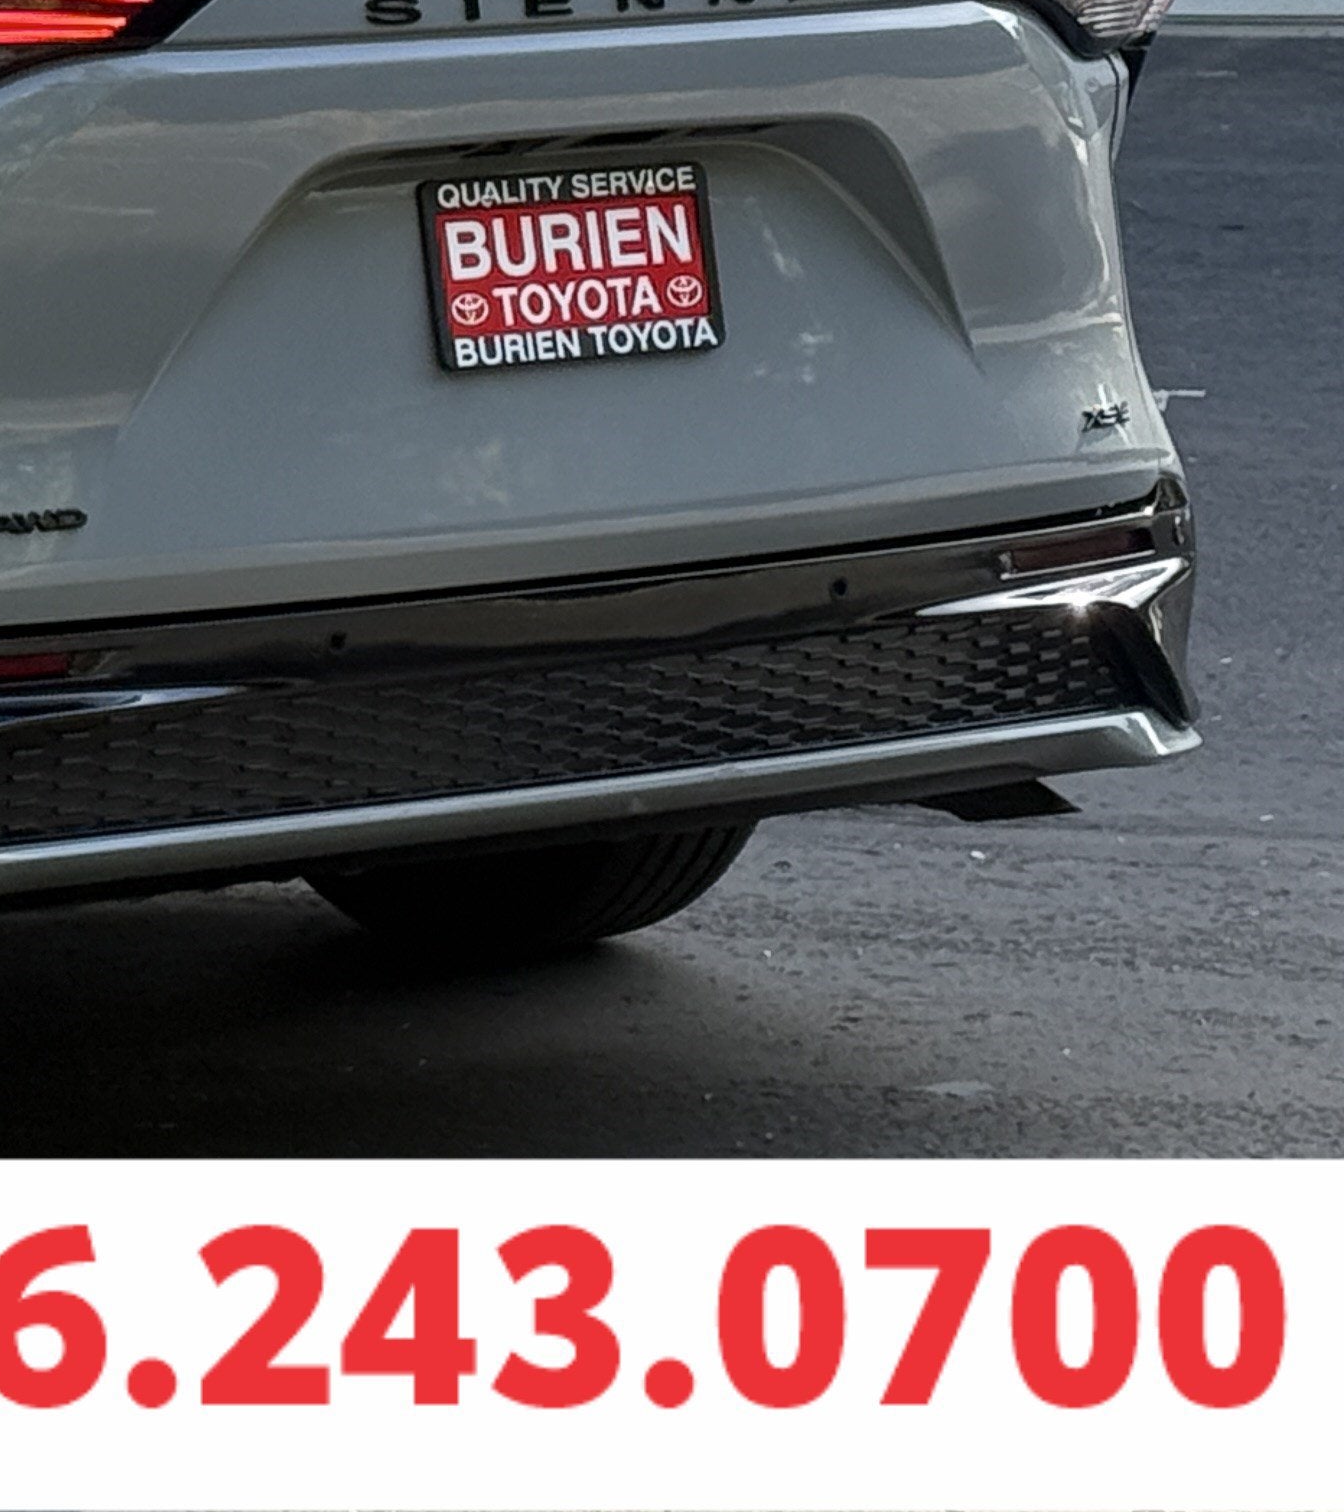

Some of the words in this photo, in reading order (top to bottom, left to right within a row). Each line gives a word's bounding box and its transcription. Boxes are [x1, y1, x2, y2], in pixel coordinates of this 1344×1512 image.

[437, 173, 564, 209] QUALITY
[570, 165, 697, 199] SERVICE
[443, 203, 694, 282] BURIEN
[491, 274, 662, 327] TOYOTA
[453, 328, 581, 368] BURIEN
[587, 317, 719, 356] TOYOTA
